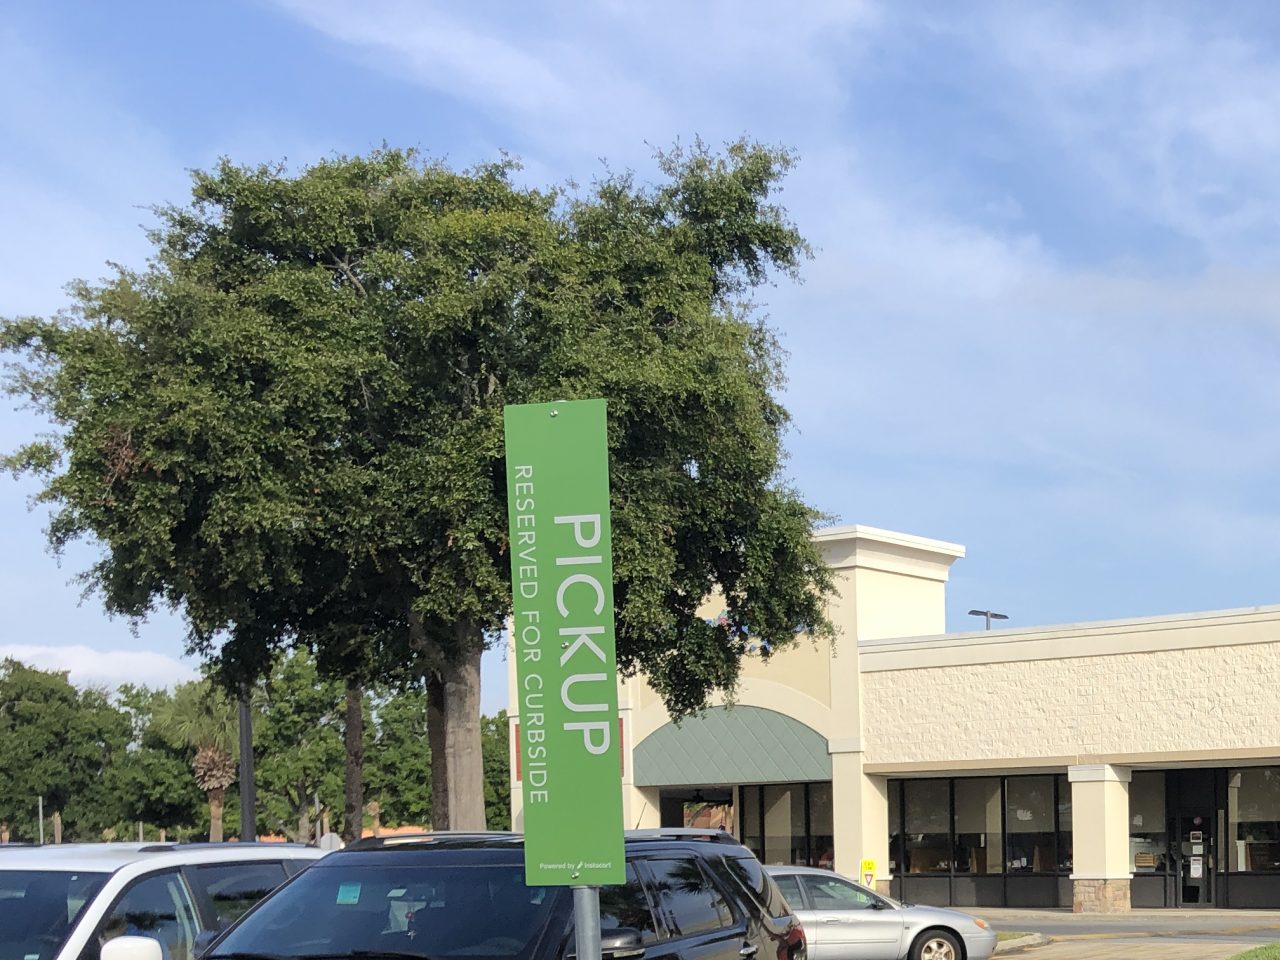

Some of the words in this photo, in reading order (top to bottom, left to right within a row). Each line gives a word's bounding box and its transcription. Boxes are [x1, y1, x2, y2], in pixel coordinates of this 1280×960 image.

[515, 466, 538, 598] RESERVED
[522, 611, 541, 662] FOR
[554, 514, 611, 755] PICKUP
[524, 674, 548, 803] CURBSIDE
